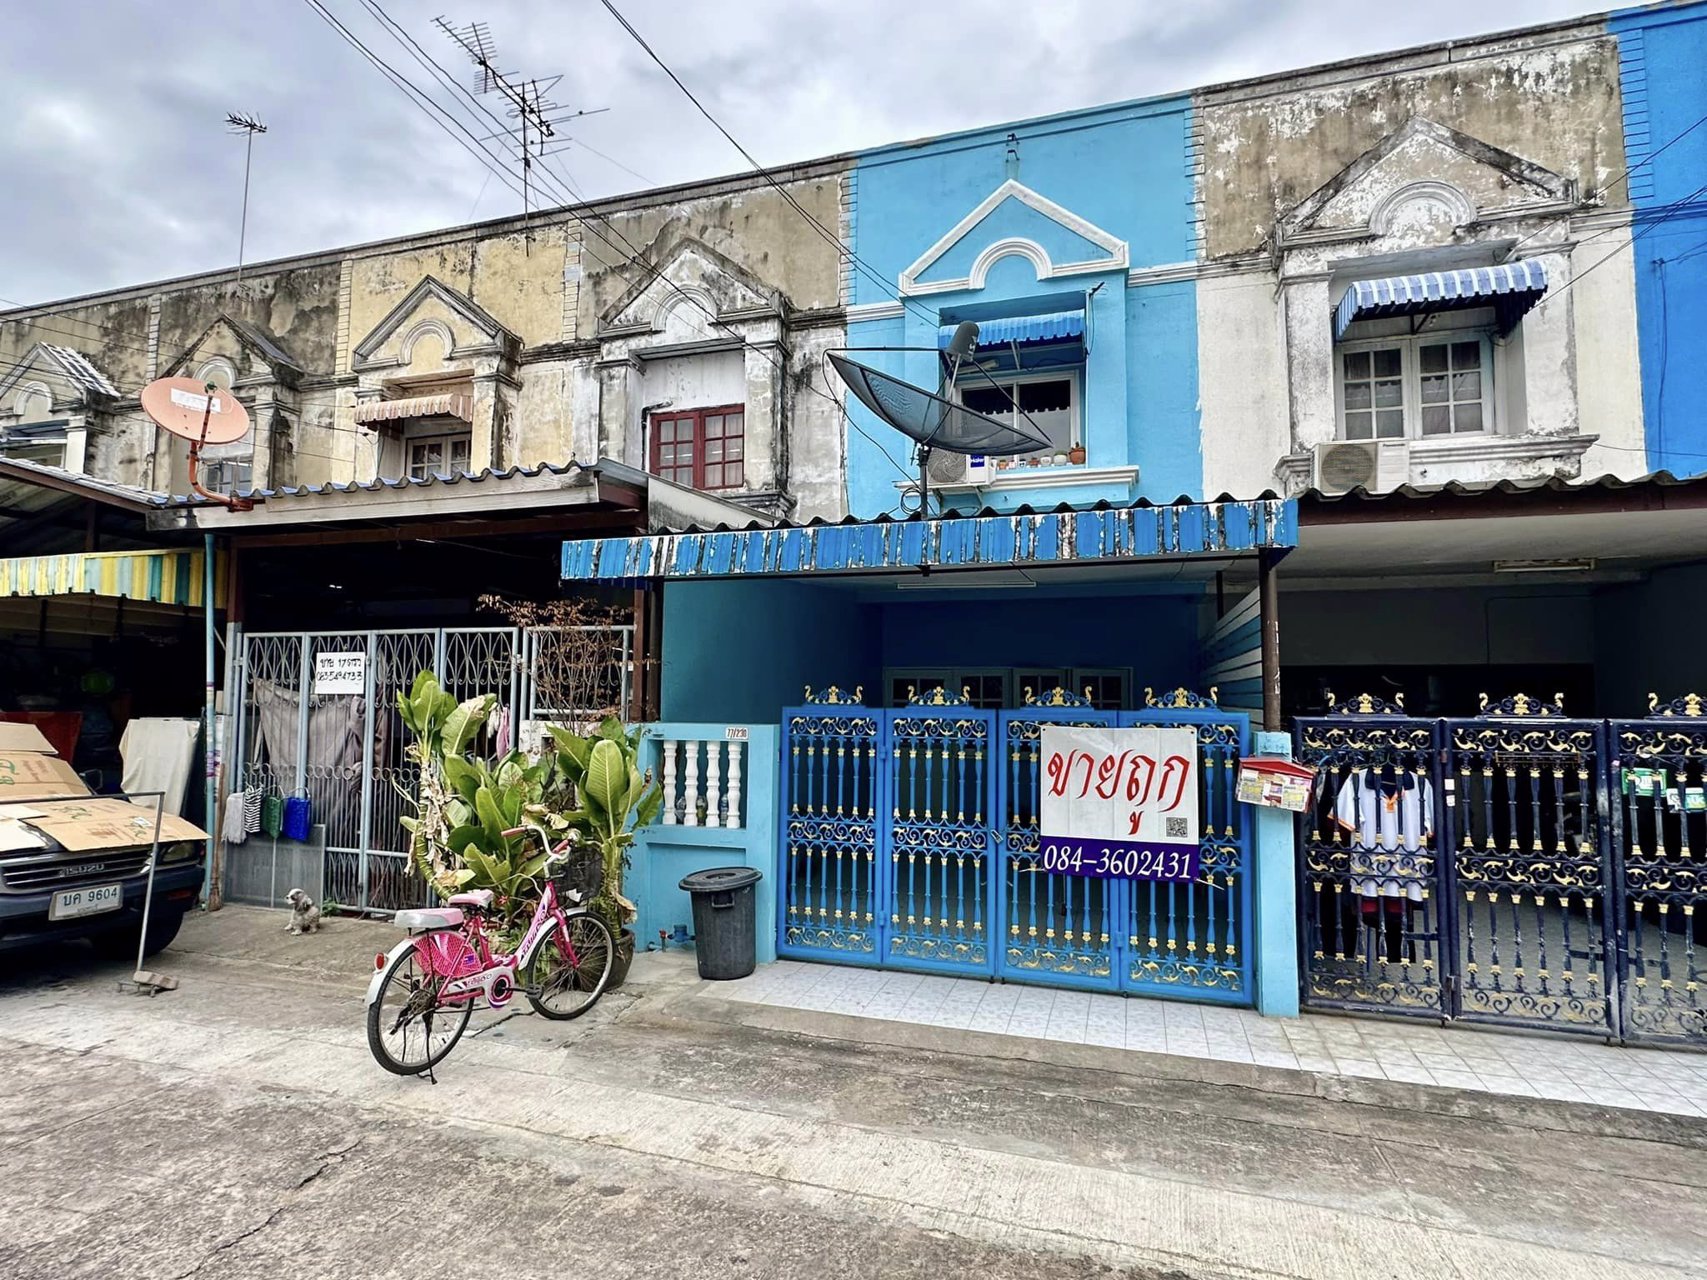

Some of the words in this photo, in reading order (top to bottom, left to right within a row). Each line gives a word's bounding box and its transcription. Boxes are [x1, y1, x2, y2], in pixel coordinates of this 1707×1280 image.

[1047, 749, 1190, 835] ขายถูก
[1043, 844, 1191, 879] 084-3602431
[63, 893, 82, 907] บค
[88, 887, 117, 902] 9604
